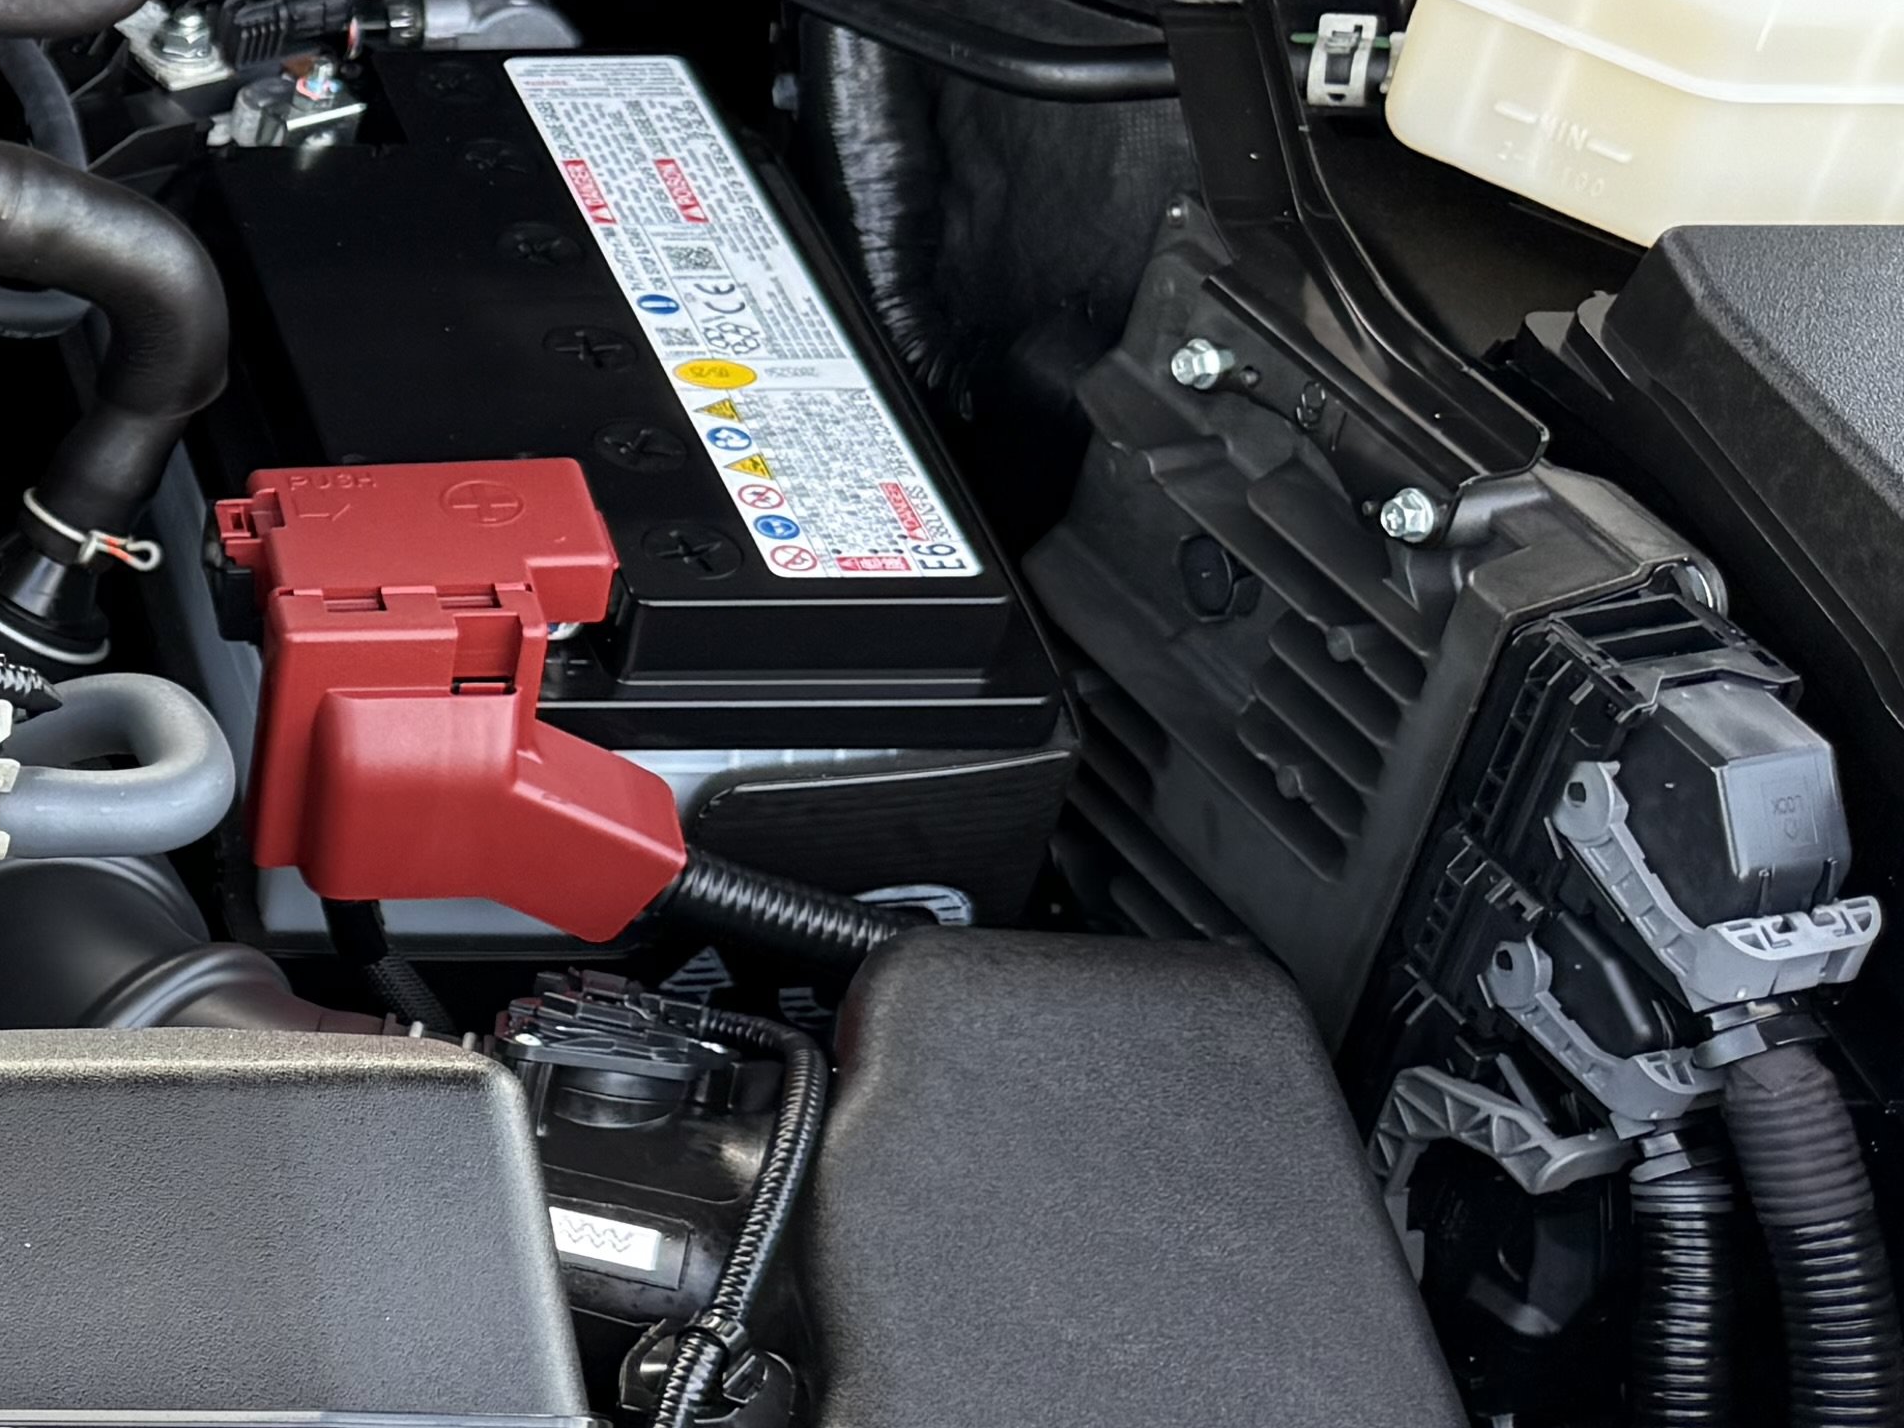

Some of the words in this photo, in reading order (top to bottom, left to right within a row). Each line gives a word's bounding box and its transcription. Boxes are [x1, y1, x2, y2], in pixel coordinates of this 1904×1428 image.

[564, 163, 605, 205] DANGER
[656, 162, 699, 205] POISON
[290, 473, 377, 491] PUSH
[879, 482, 922, 528] DANGER
[907, 543, 968, 569] E6
